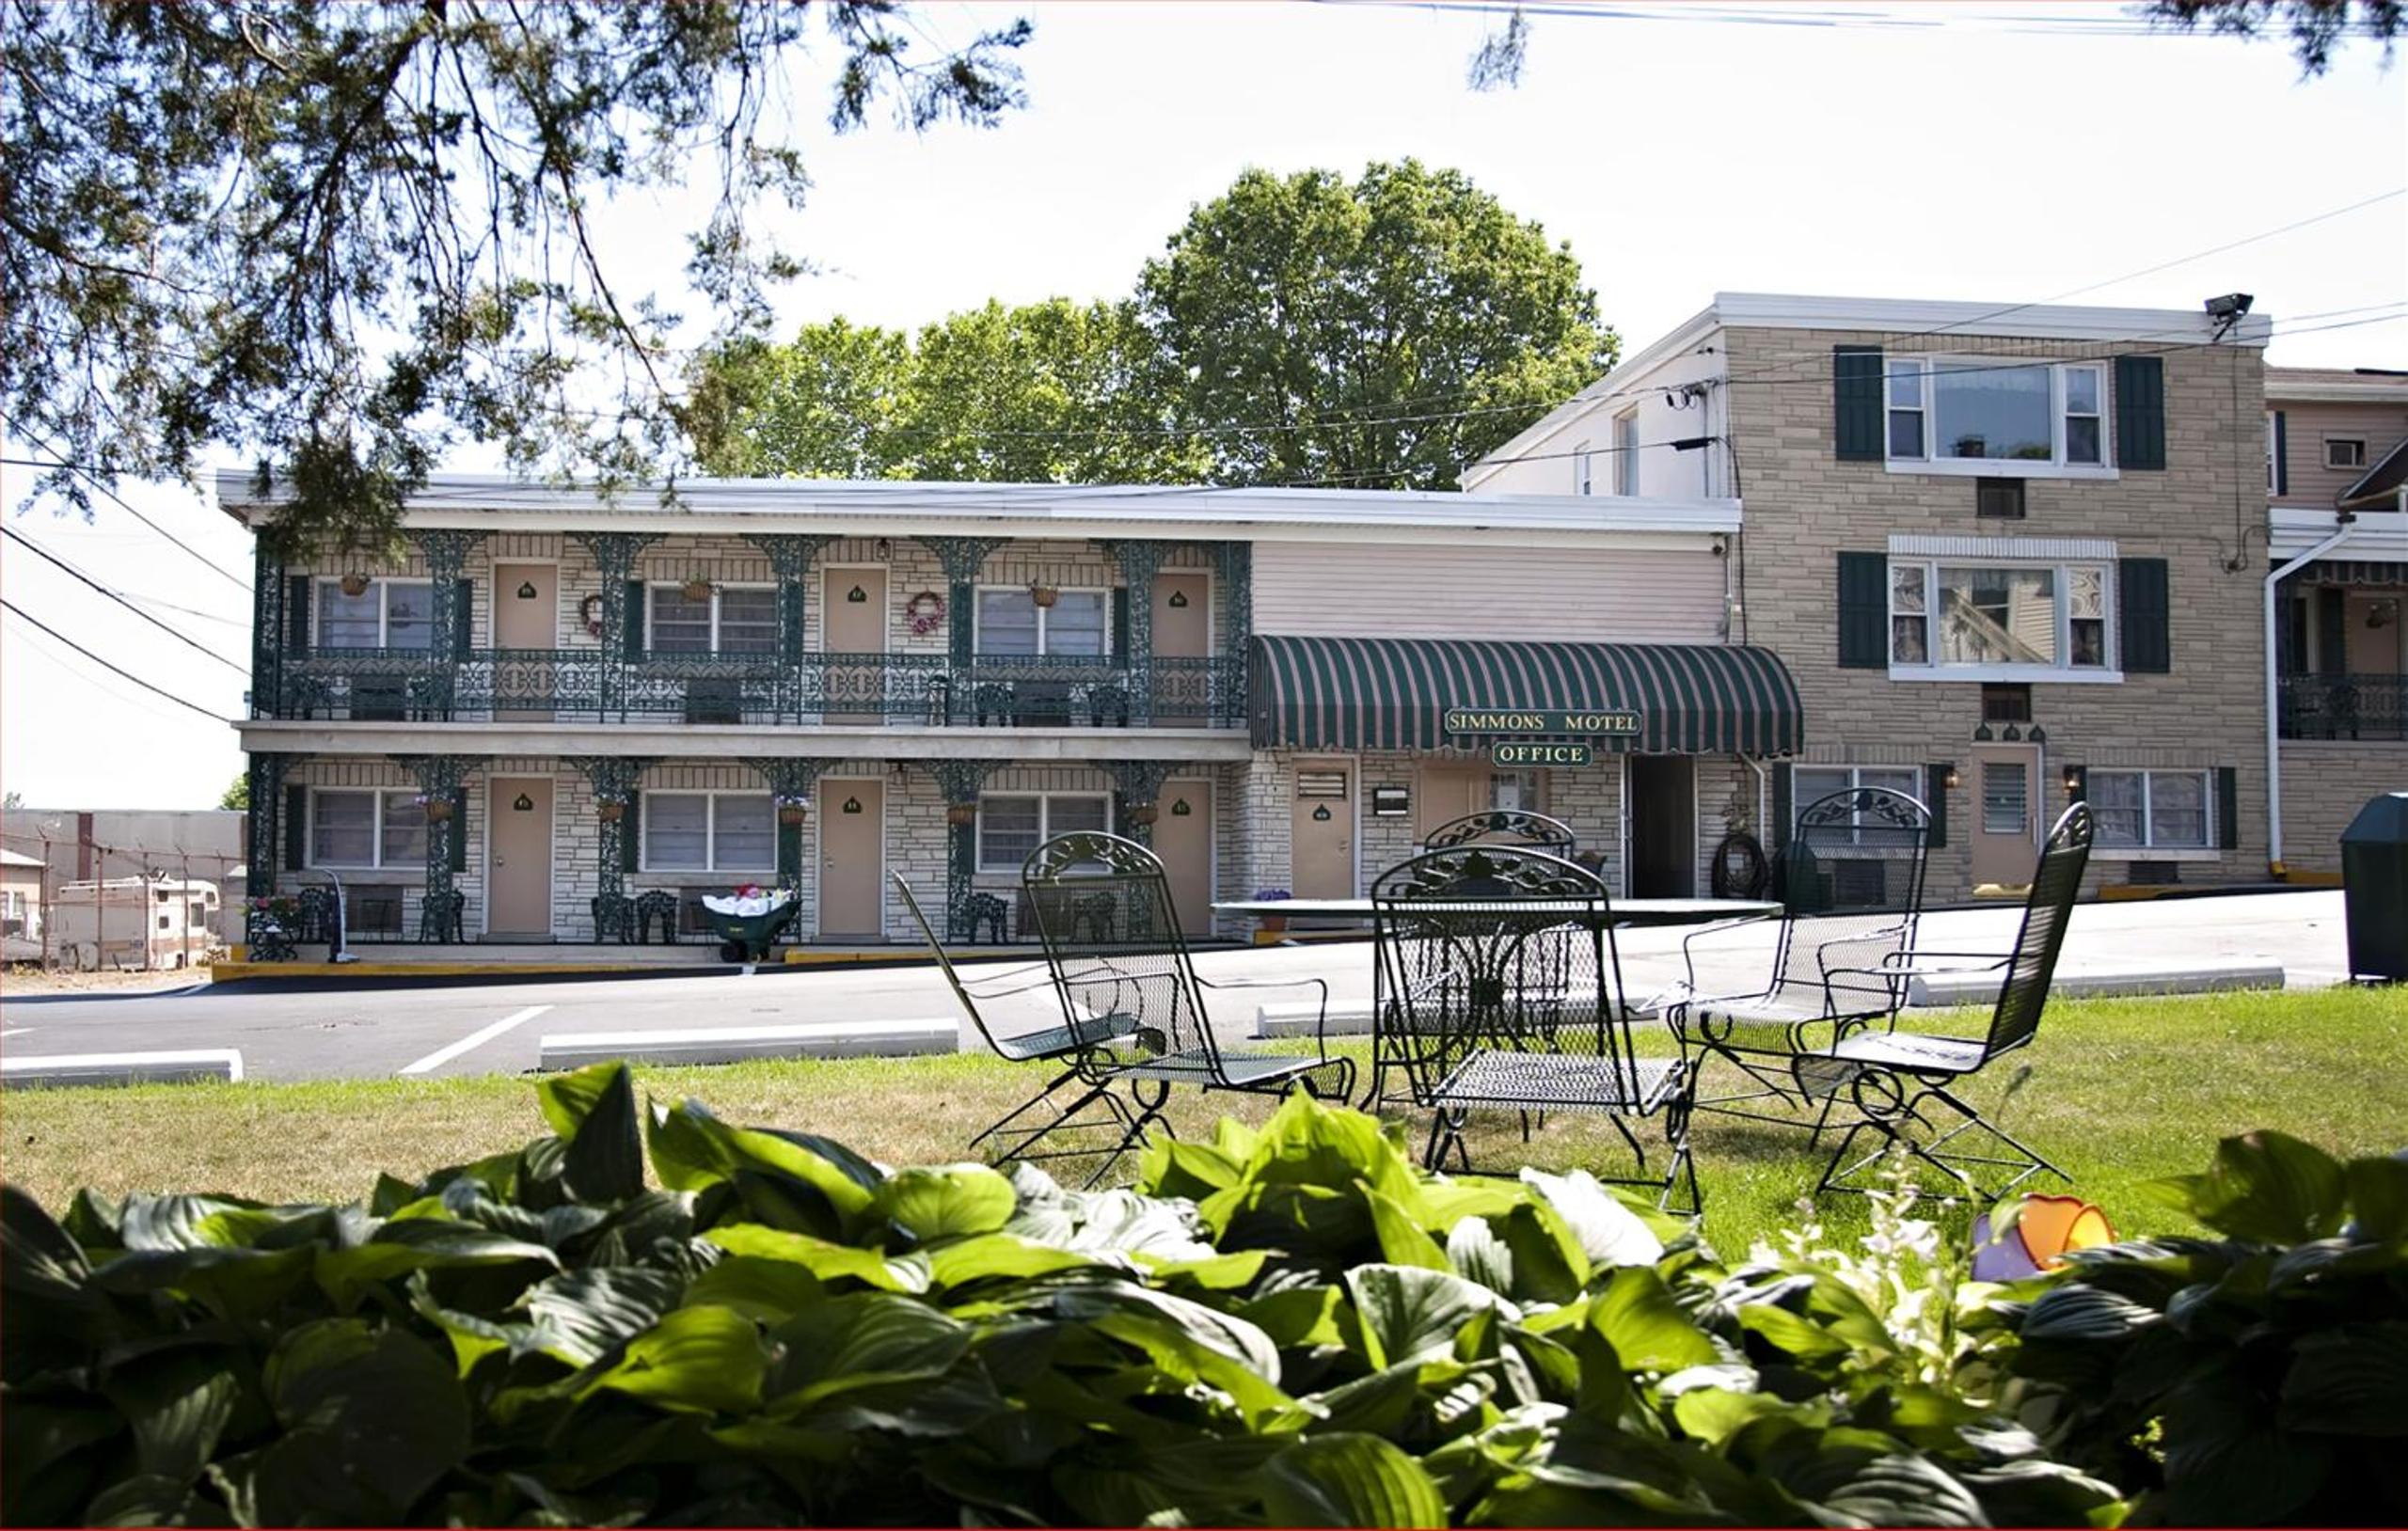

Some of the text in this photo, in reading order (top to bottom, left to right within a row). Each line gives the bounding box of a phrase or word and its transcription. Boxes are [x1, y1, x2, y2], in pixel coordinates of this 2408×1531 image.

[1449, 713, 1638, 732] SIMMONS MOTEL
[1499, 746, 1584, 763] OFFICE
